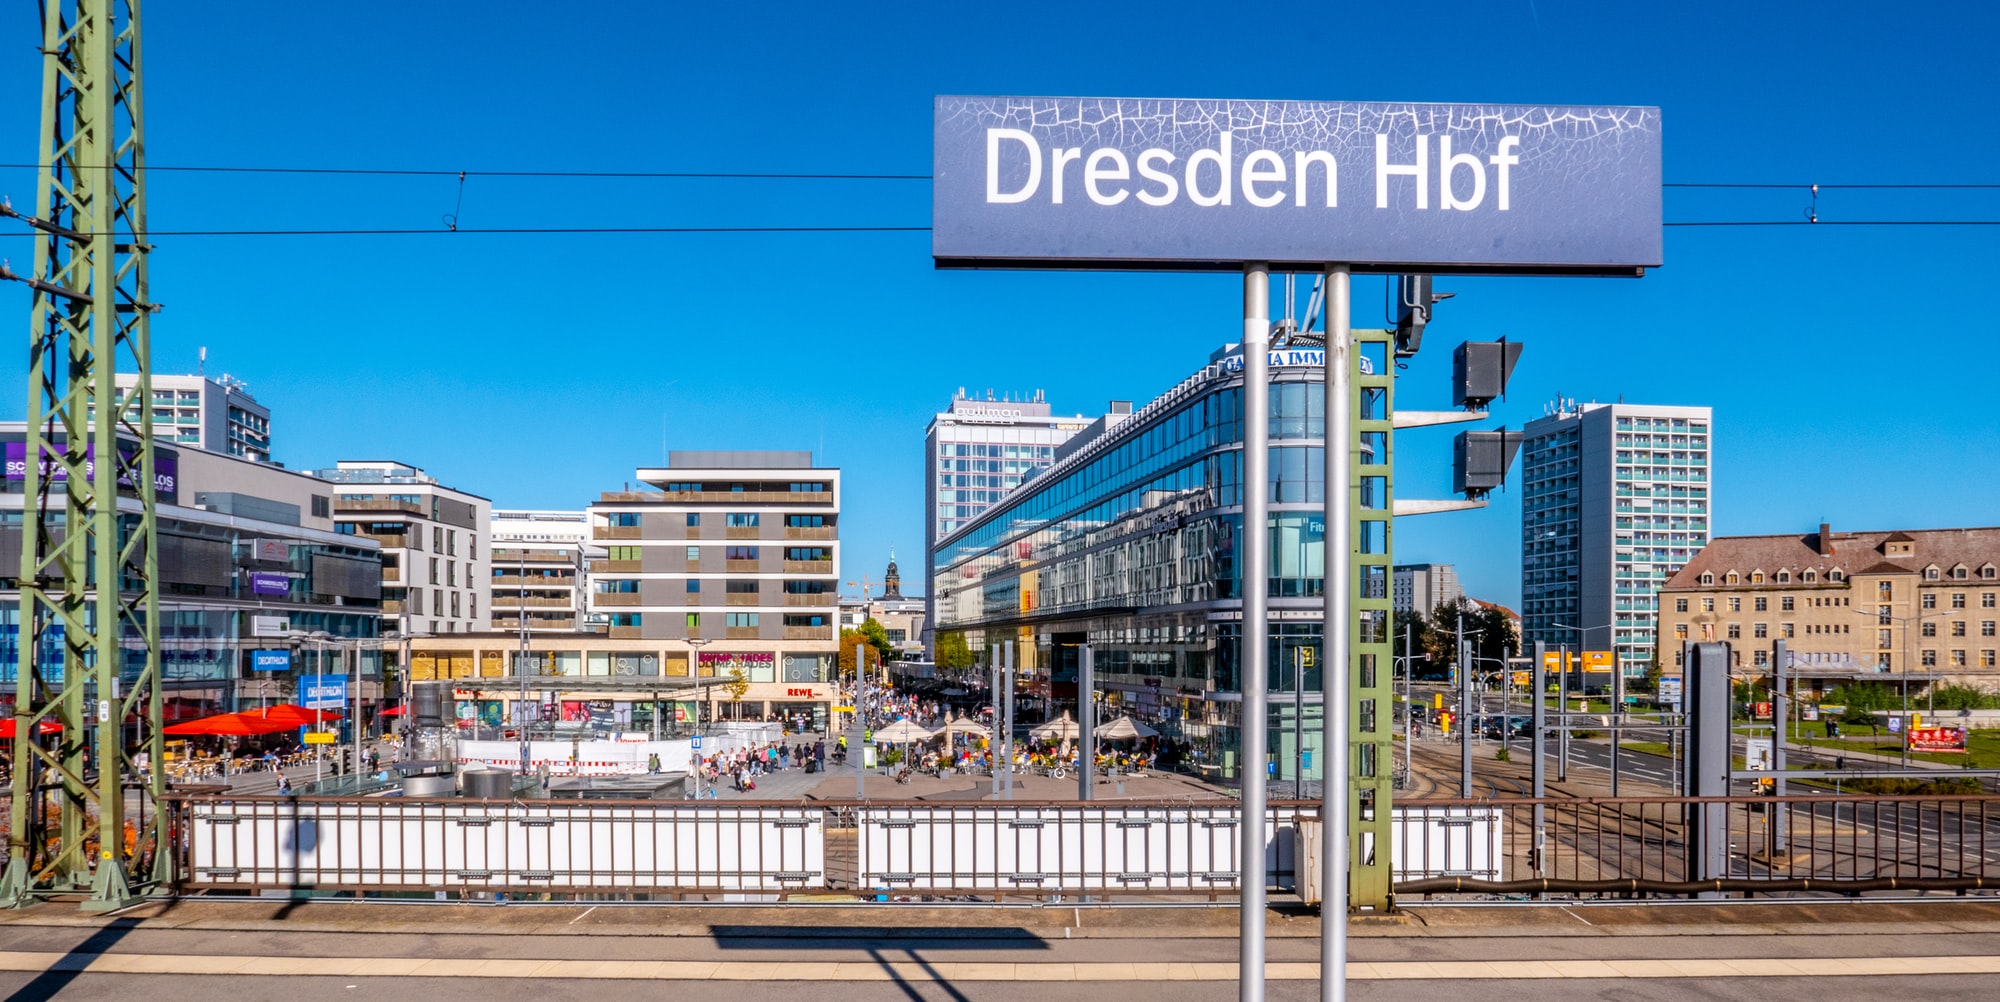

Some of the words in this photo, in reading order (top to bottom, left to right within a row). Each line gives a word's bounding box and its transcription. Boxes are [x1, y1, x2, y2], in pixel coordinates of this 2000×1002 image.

[985, 127, 1339, 209] Dresden
[1374, 133, 1521, 212] Hbf
[955, 406, 1022, 420] pullman
[787, 688, 813, 697] REWE
